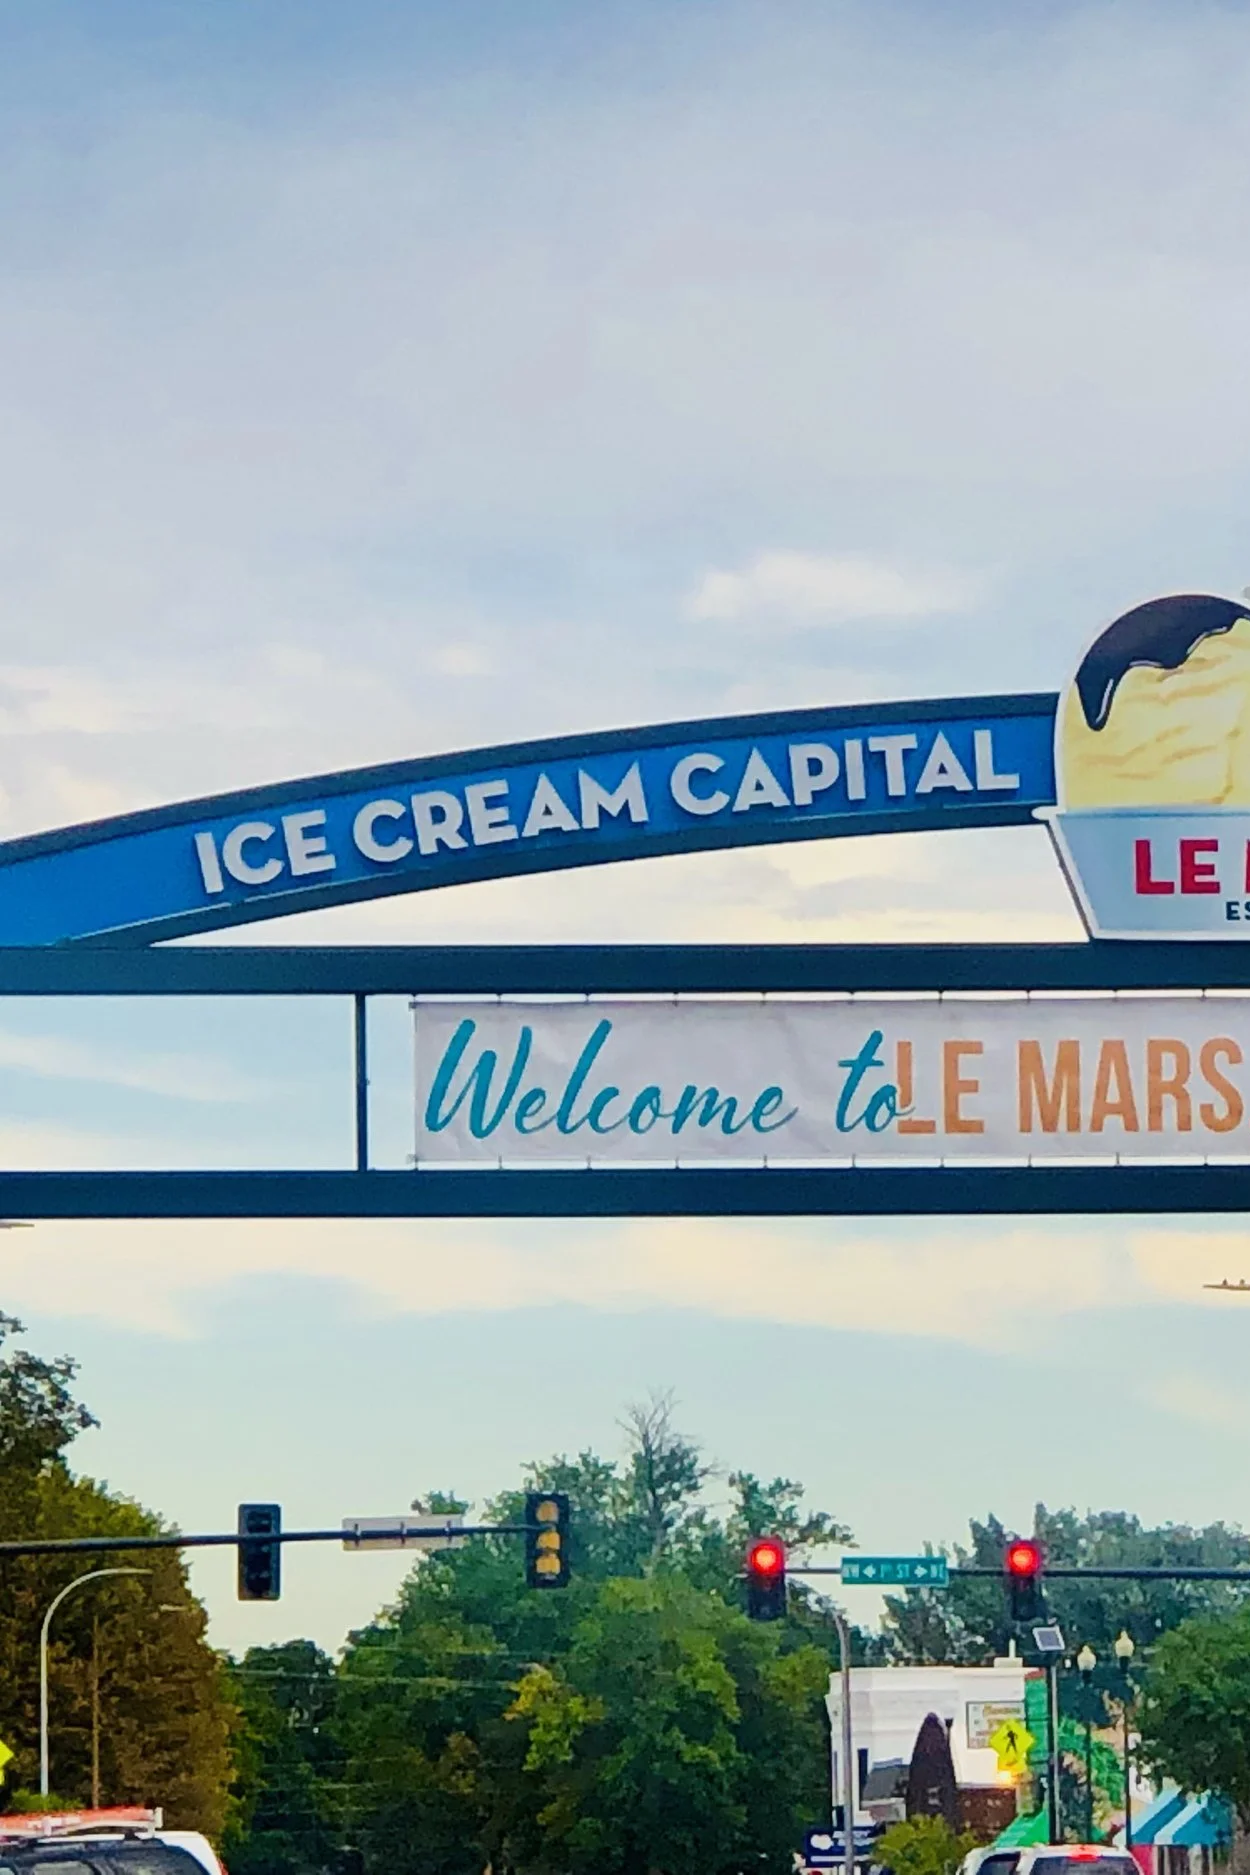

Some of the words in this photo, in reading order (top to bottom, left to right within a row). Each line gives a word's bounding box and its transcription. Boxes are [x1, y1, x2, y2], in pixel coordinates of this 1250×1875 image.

[194, 809, 337, 894] ICE
[352, 758, 648, 863] CREAM
[670, 728, 1020, 817] CAPITAL
[1134, 838, 1220, 895] LE
[424, 1018, 799, 1138] Welcome
[834, 1029, 916, 1134] to
[896, 1038, 985, 1134] LE
